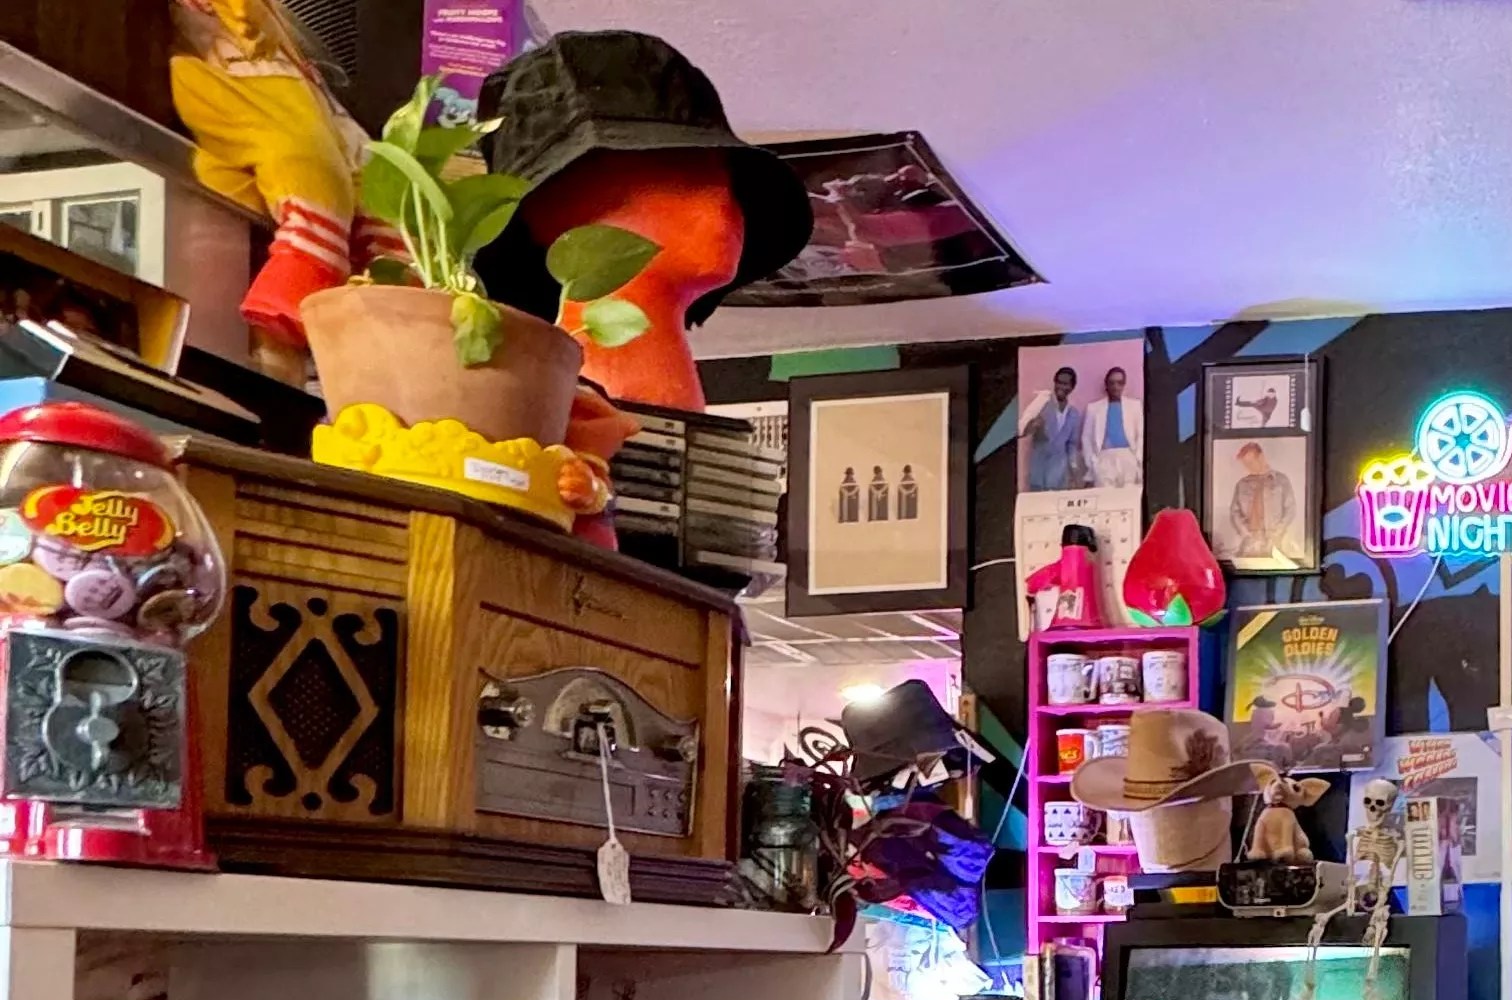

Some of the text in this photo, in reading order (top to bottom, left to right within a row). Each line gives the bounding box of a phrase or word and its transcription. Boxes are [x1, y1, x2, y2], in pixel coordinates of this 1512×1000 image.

[72, 493, 139, 527] Jelly
[46, 512, 128, 545] Belly
[1282, 626, 1339, 643] GOLDEN
[1284, 641, 1335, 658] OLDIES
